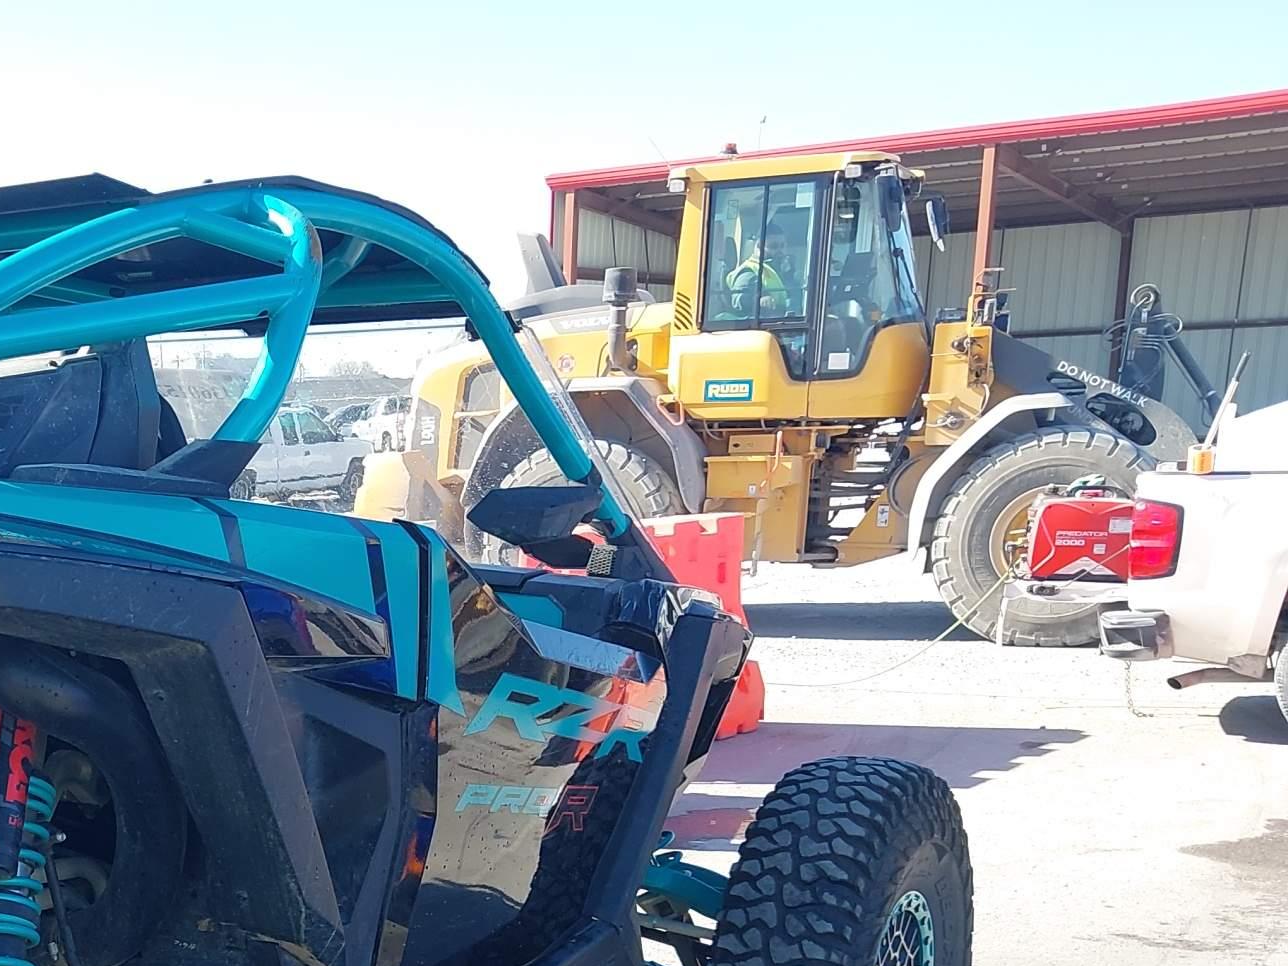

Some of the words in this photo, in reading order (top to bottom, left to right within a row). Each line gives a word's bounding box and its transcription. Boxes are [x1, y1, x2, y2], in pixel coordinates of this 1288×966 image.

[708, 384, 749, 398] RUDD
[1057, 361, 1078, 376] DO
[1078, 371, 1110, 389] NOT
[1111, 383, 1149, 408] WALK
[463, 673, 656, 763] RZR
[454, 784, 559, 817] PRO
[542, 785, 599, 838] R
